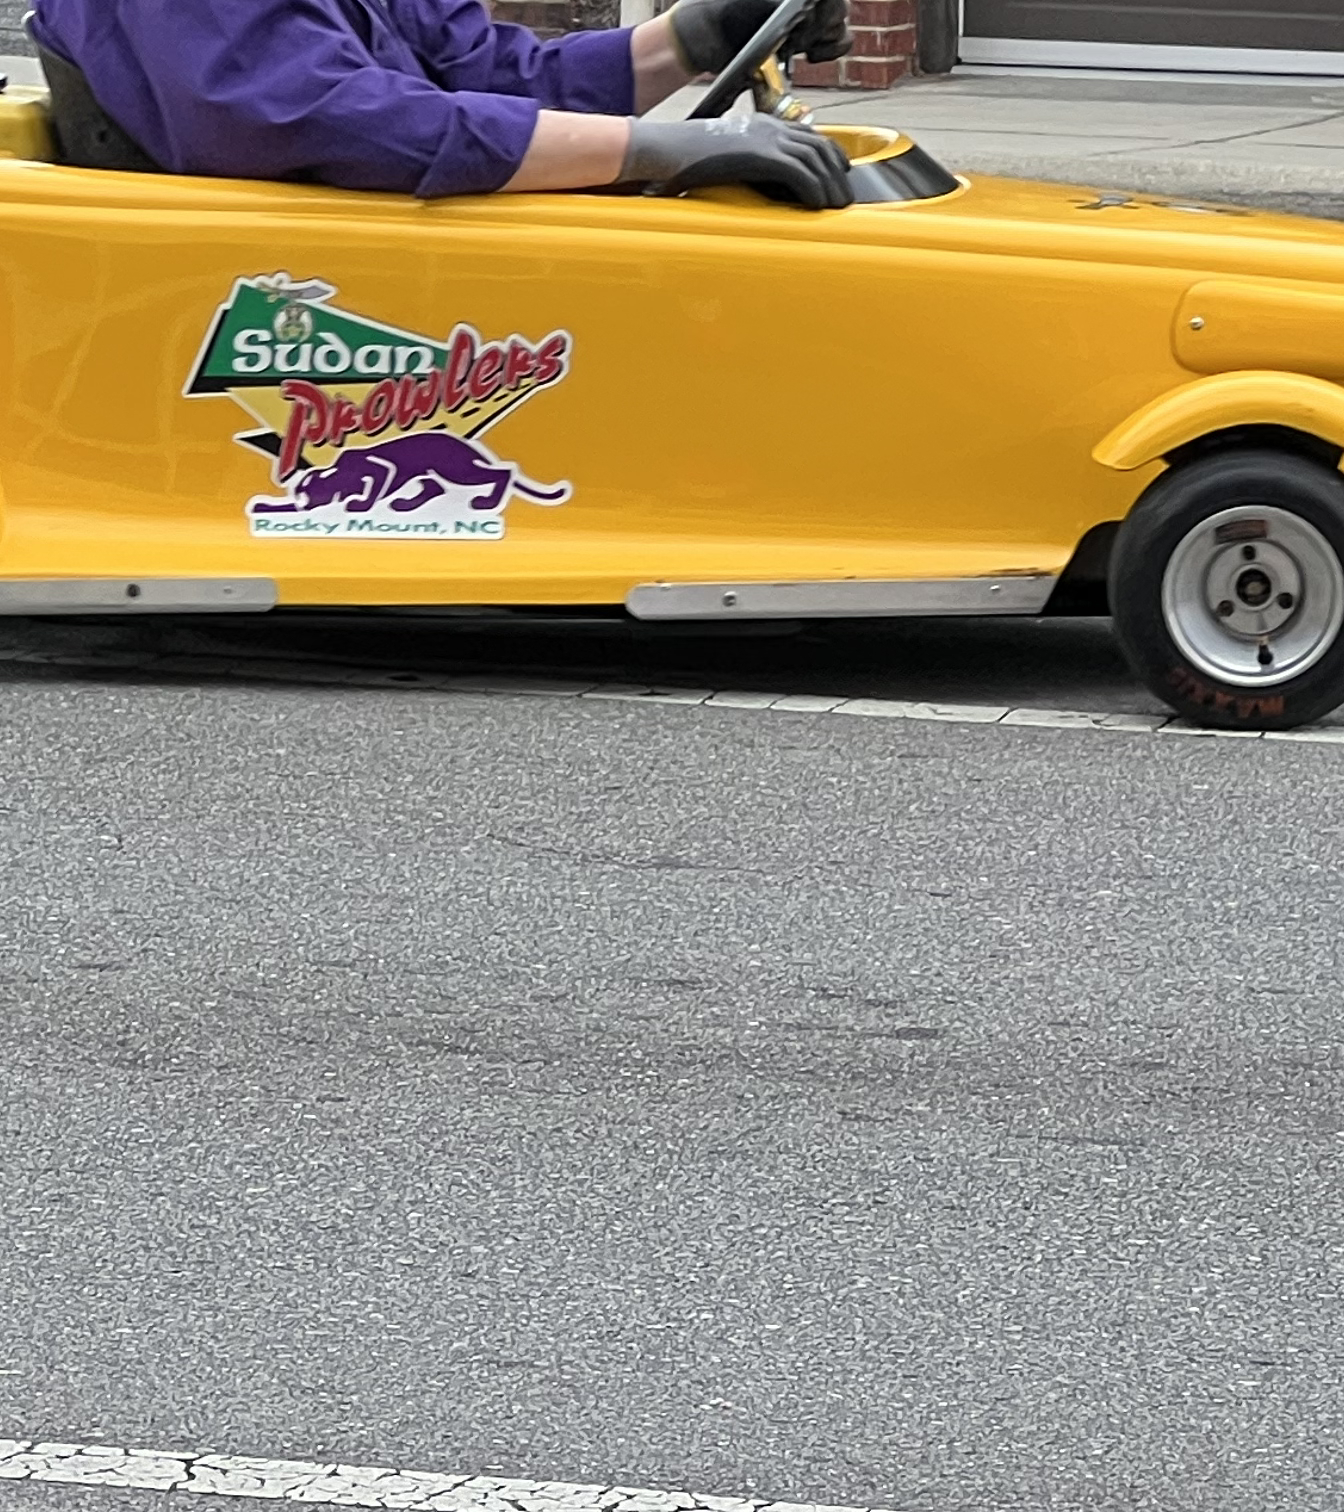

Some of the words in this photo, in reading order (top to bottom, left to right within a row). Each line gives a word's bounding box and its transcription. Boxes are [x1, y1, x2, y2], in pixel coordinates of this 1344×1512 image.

[232, 329, 435, 375] Sudan
[279, 328, 568, 484] Prowlers
[255, 518, 341, 535] Rocky
[347, 519, 448, 536] Mount,
[455, 520, 501, 535] NC
